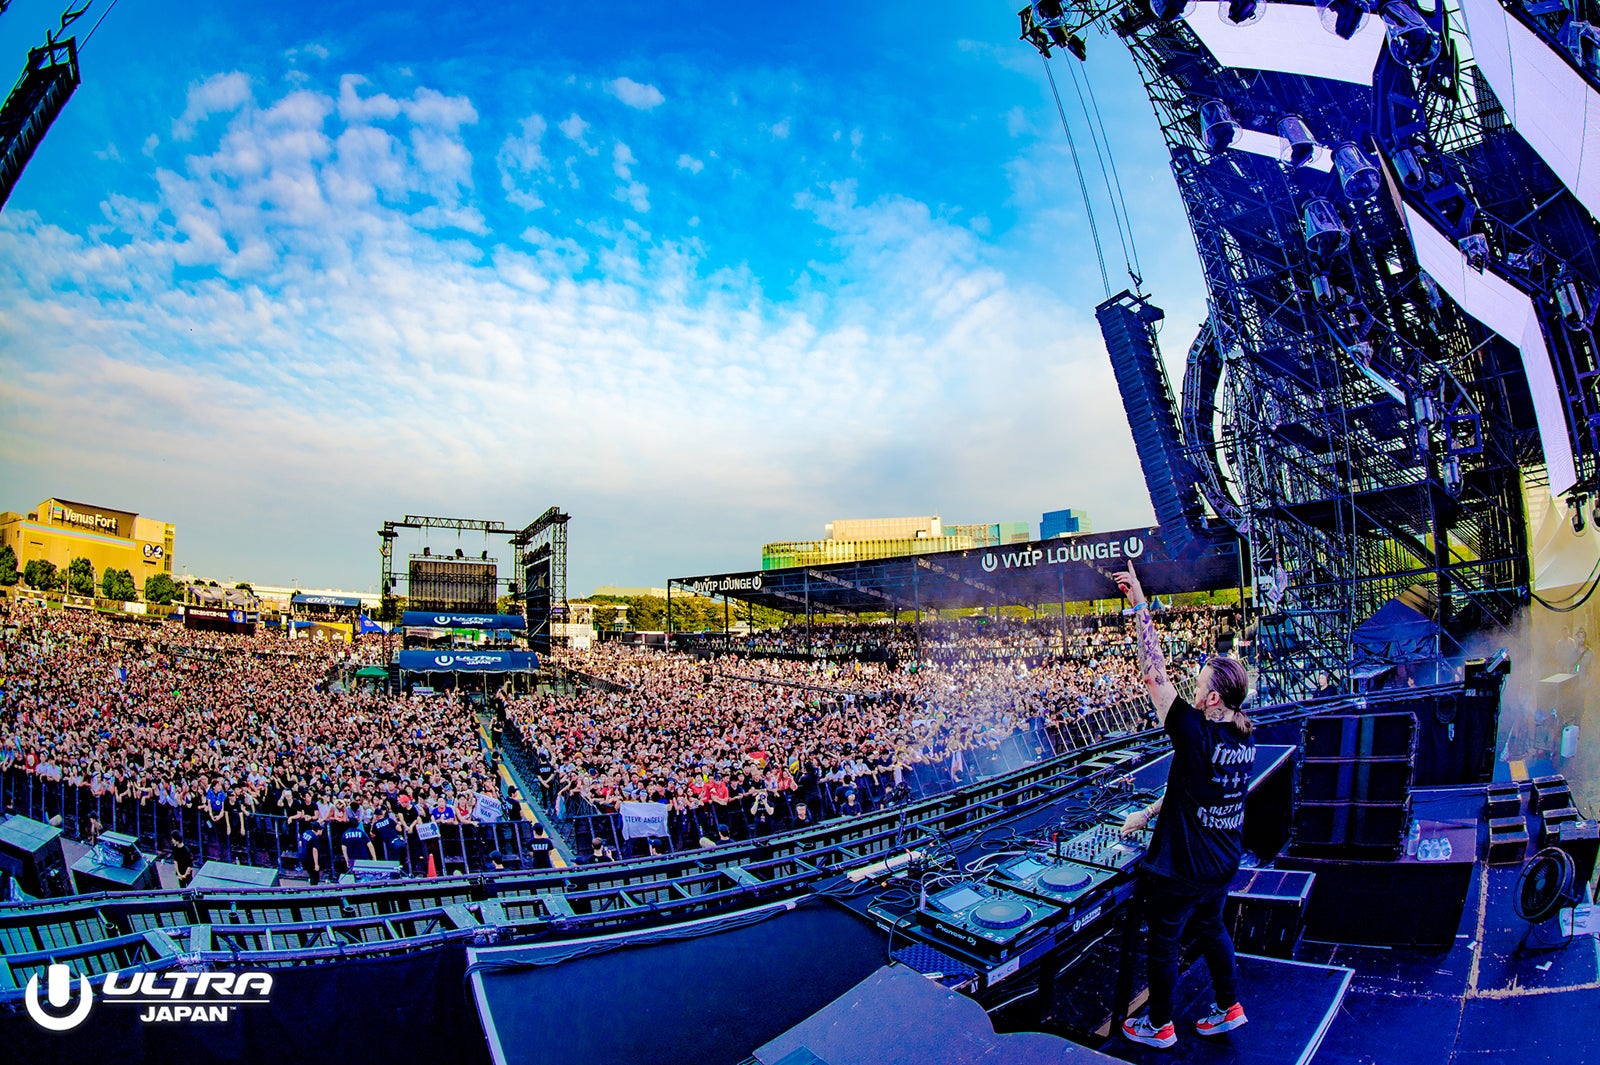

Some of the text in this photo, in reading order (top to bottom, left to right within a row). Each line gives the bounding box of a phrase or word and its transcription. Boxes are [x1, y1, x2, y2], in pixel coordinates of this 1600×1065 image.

[1002, 541, 1121, 569] VVIP LOUNGE
[719, 578, 752, 591] LOUNGE
[345, 831, 363, 839] STAFF
[531, 843, 549, 851] STAFF
[935, 923, 977, 946] Pioneer DJ
